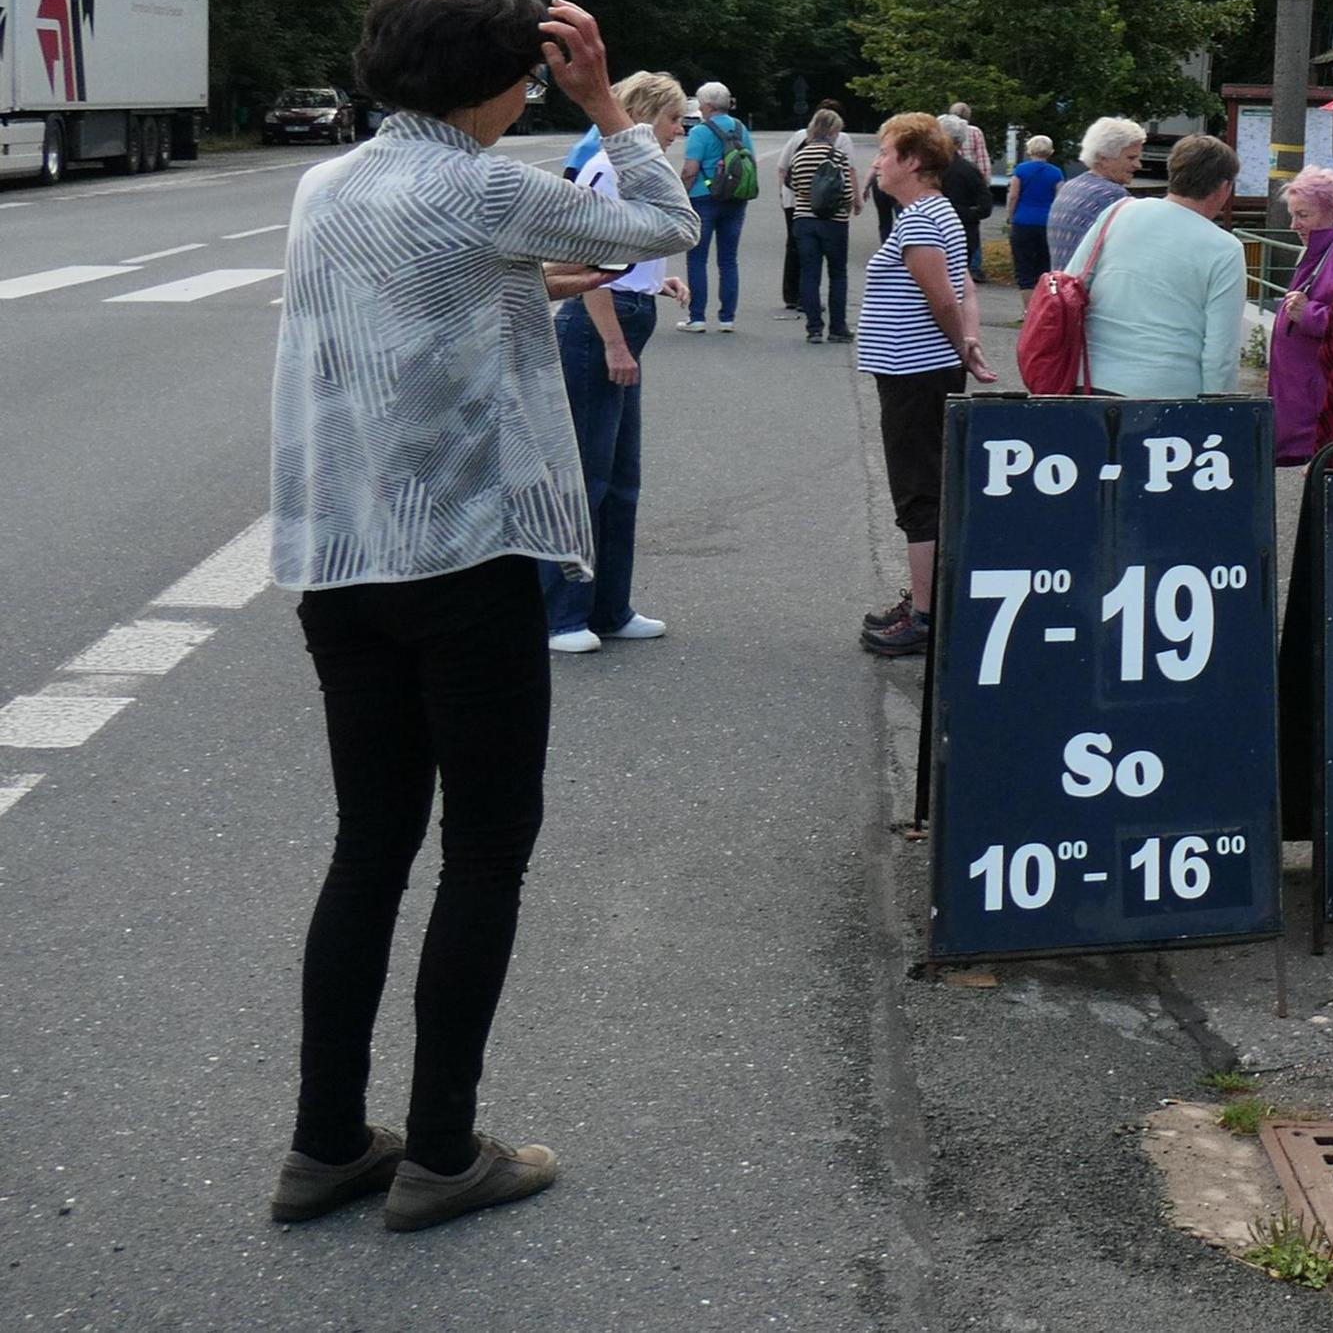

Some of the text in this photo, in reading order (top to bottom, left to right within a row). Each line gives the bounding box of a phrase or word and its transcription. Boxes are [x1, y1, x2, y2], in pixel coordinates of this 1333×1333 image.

[981, 439, 1079, 497] Po
[1142, 433, 1234, 494] Pá
[1062, 731, 1165, 798] So
